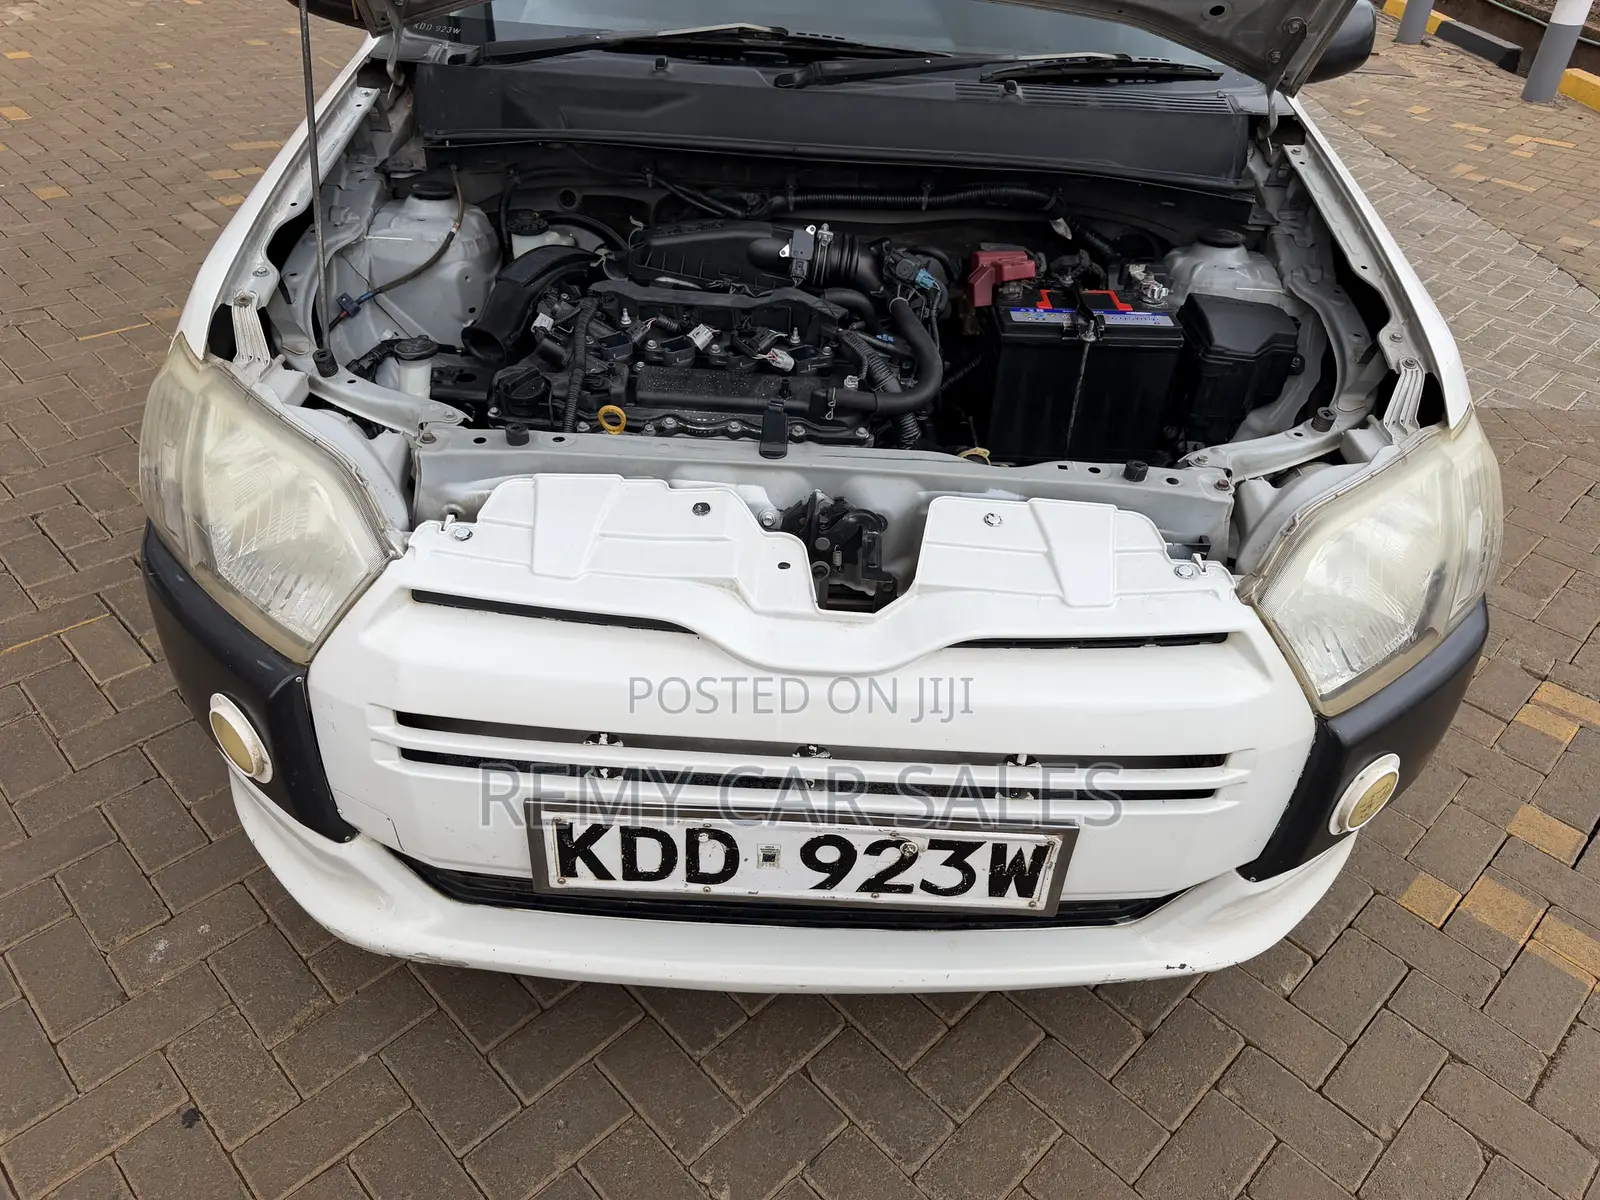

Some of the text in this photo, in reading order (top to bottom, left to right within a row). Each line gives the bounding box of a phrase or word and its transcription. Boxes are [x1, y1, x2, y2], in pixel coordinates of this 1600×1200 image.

[413, 22, 461, 34] KDD 923W
[556, 821, 1052, 898] KDD 923W
